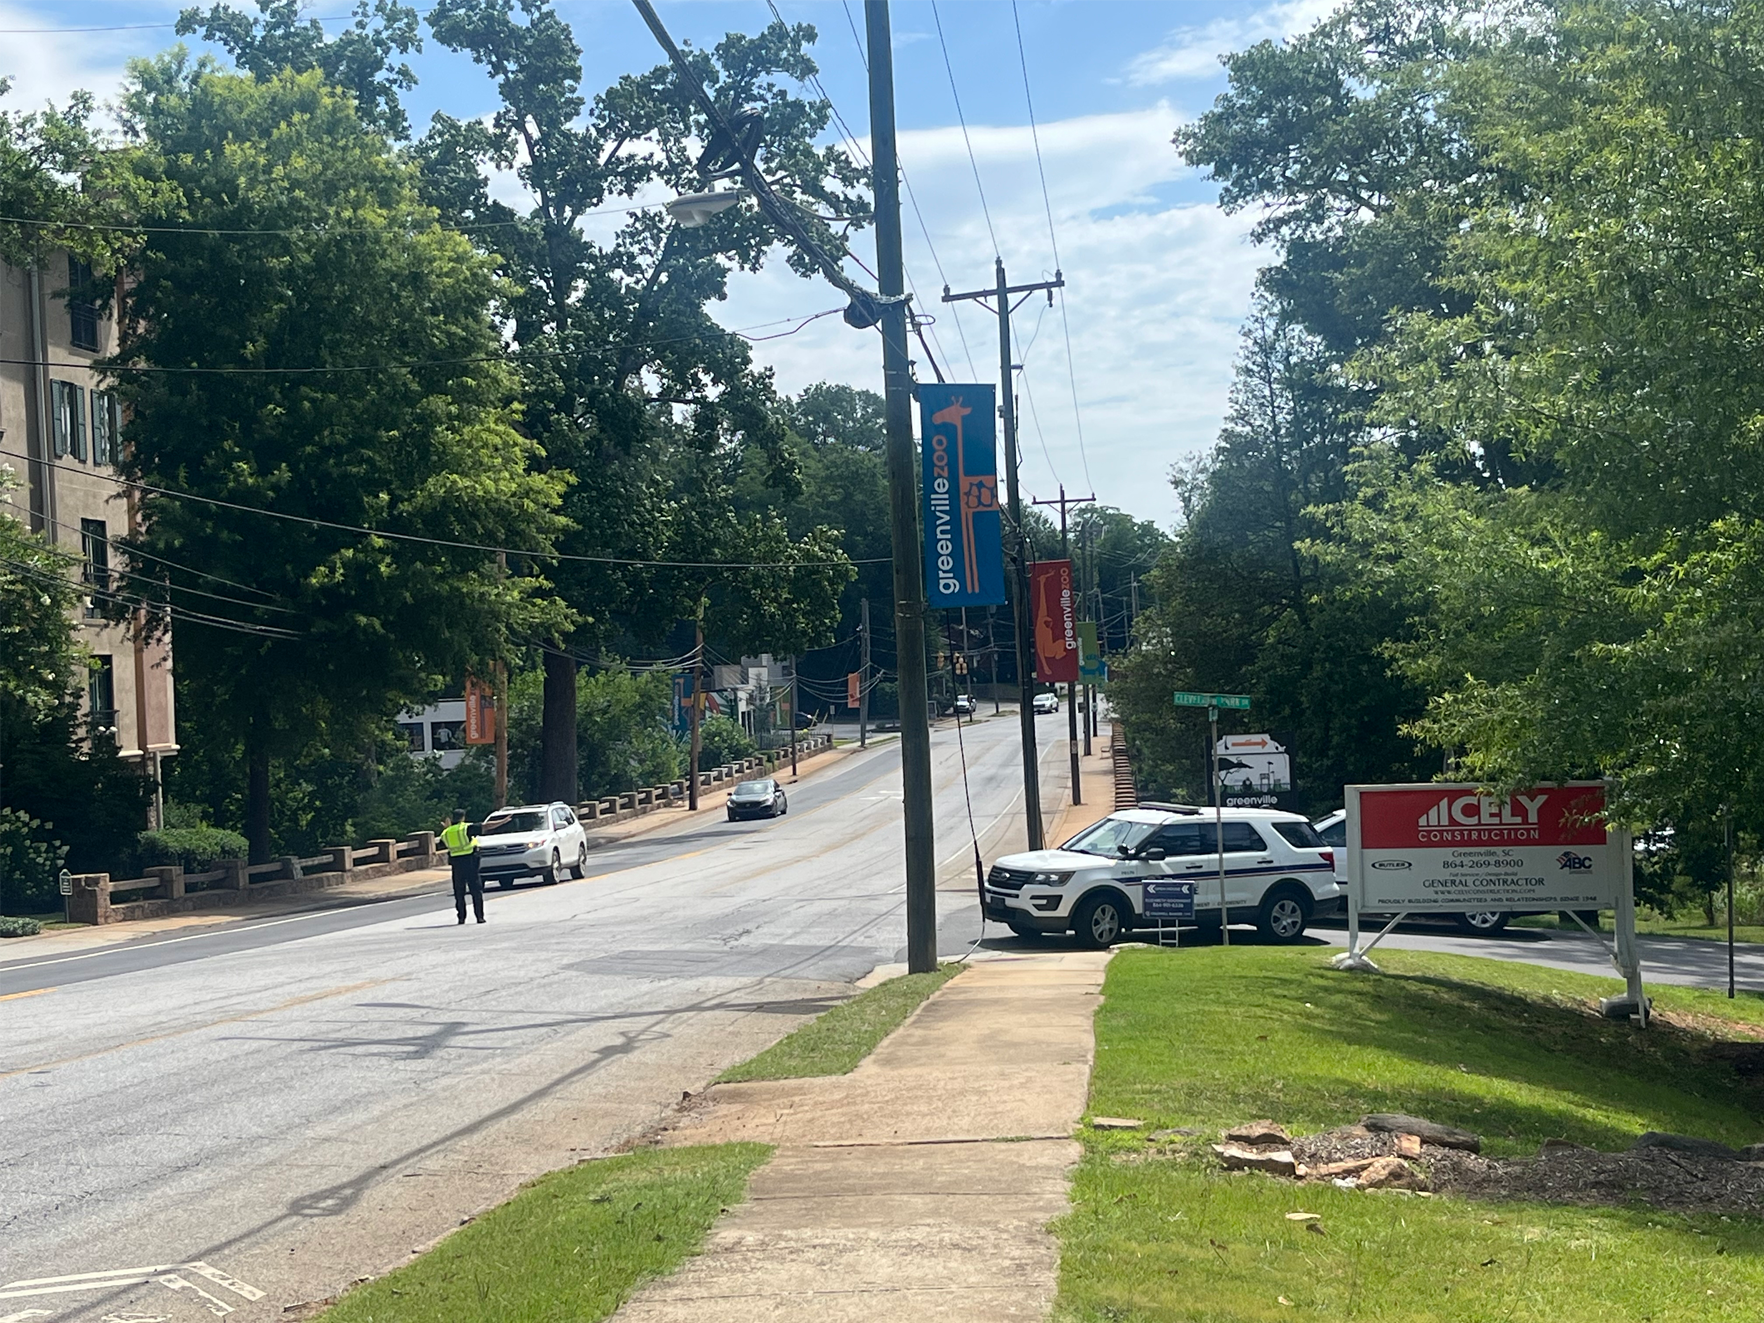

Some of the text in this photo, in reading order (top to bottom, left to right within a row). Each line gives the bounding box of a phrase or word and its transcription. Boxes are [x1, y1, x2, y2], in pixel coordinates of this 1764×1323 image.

[931, 435, 960, 595] greenvillezoo
[1060, 567, 1077, 650] greenvillezoo
[1226, 795, 1278, 807] greenville
[1451, 795, 1549, 825] CELY
[1418, 829, 1539, 842] CONSTRUCTION
[1502, 849, 1514, 857] SC
[1442, 858, 1524, 869] 864-269-8900
[1559, 856, 1593, 870] ABC
[1422, 877, 1546, 888] GENERAL CONTRACTOR
